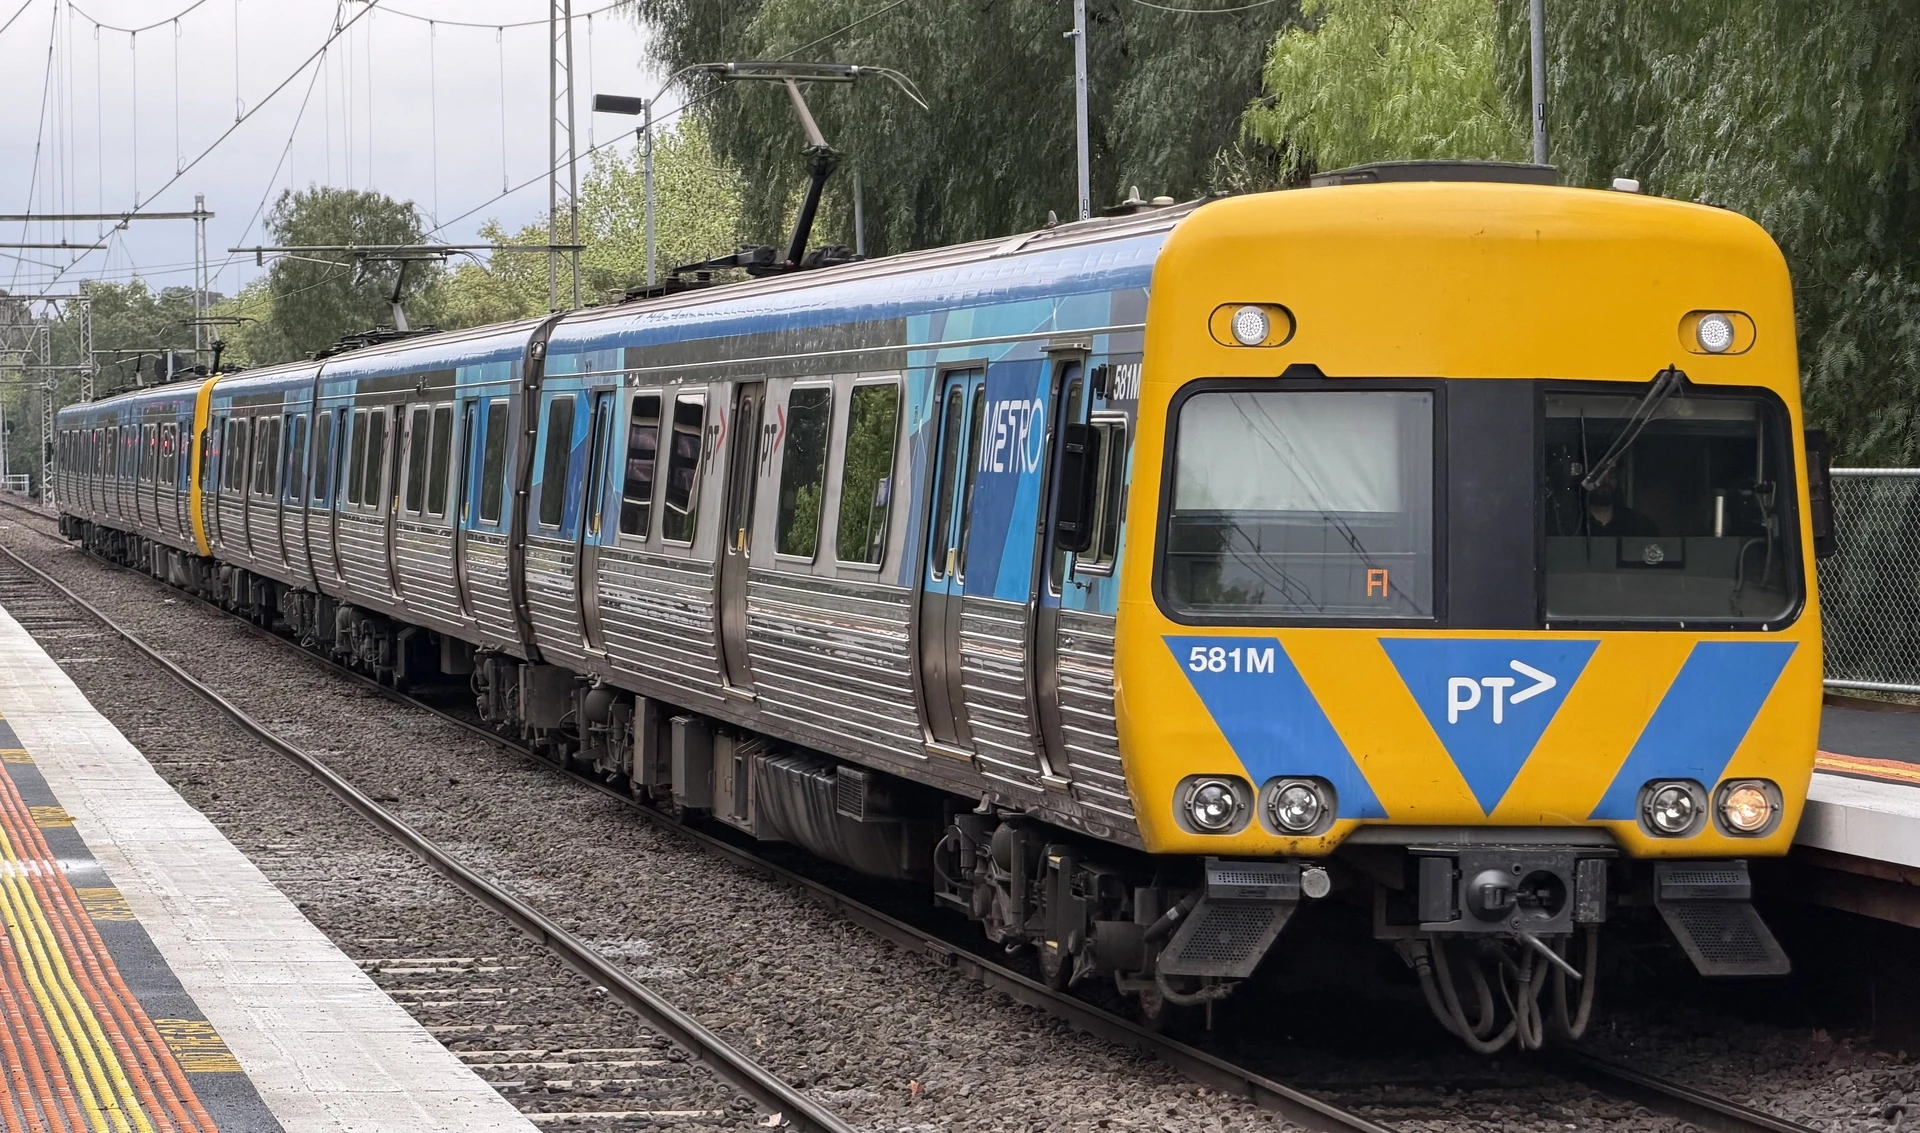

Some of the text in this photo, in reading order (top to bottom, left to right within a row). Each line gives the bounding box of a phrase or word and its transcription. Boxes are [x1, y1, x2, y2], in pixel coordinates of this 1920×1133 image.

[1113, 363, 1142, 400] 581M
[978, 398, 1044, 474] METRO
[1189, 647, 1275, 673] 581M
[154, 1019, 216, 1035] GAP
[163, 1036, 230, 1051] THE
